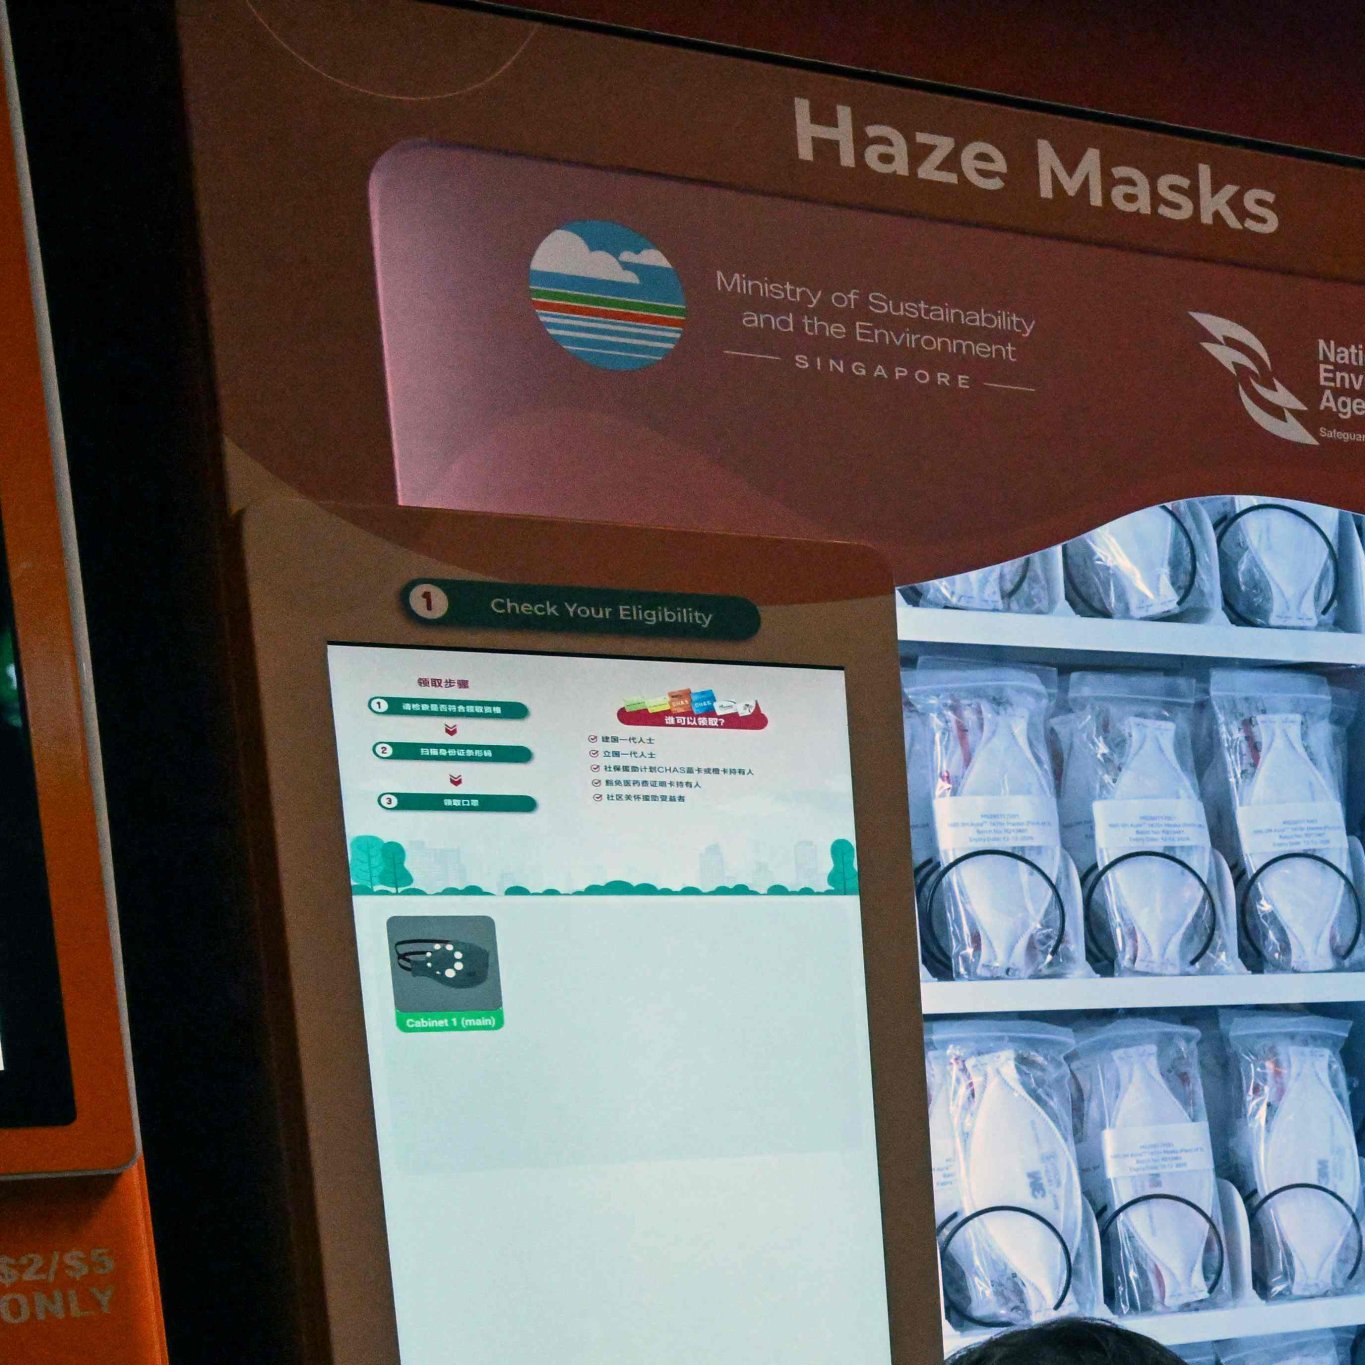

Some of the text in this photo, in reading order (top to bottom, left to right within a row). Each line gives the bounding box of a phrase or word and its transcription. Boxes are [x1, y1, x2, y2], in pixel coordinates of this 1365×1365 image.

[794, 97, 1279, 234] Haze Masks
[716, 270, 1035, 337] Ministry of Sustainability
[743, 307, 1016, 362] and the Environment
[794, 355, 972, 389] SINGAPORE
[421, 591, 713, 628] 1 Check Your Eligibility
[417, 678, 470, 689] 领取步骤
[602, 735, 655, 745] 建国一代人士
[603, 750, 656, 759] 立国一代人士
[406, 1014, 496, 1029] Cabinet 1 (main)
[1026, 1170, 1047, 1200] 3M
[0, 1285, 115, 1324] ONLY
